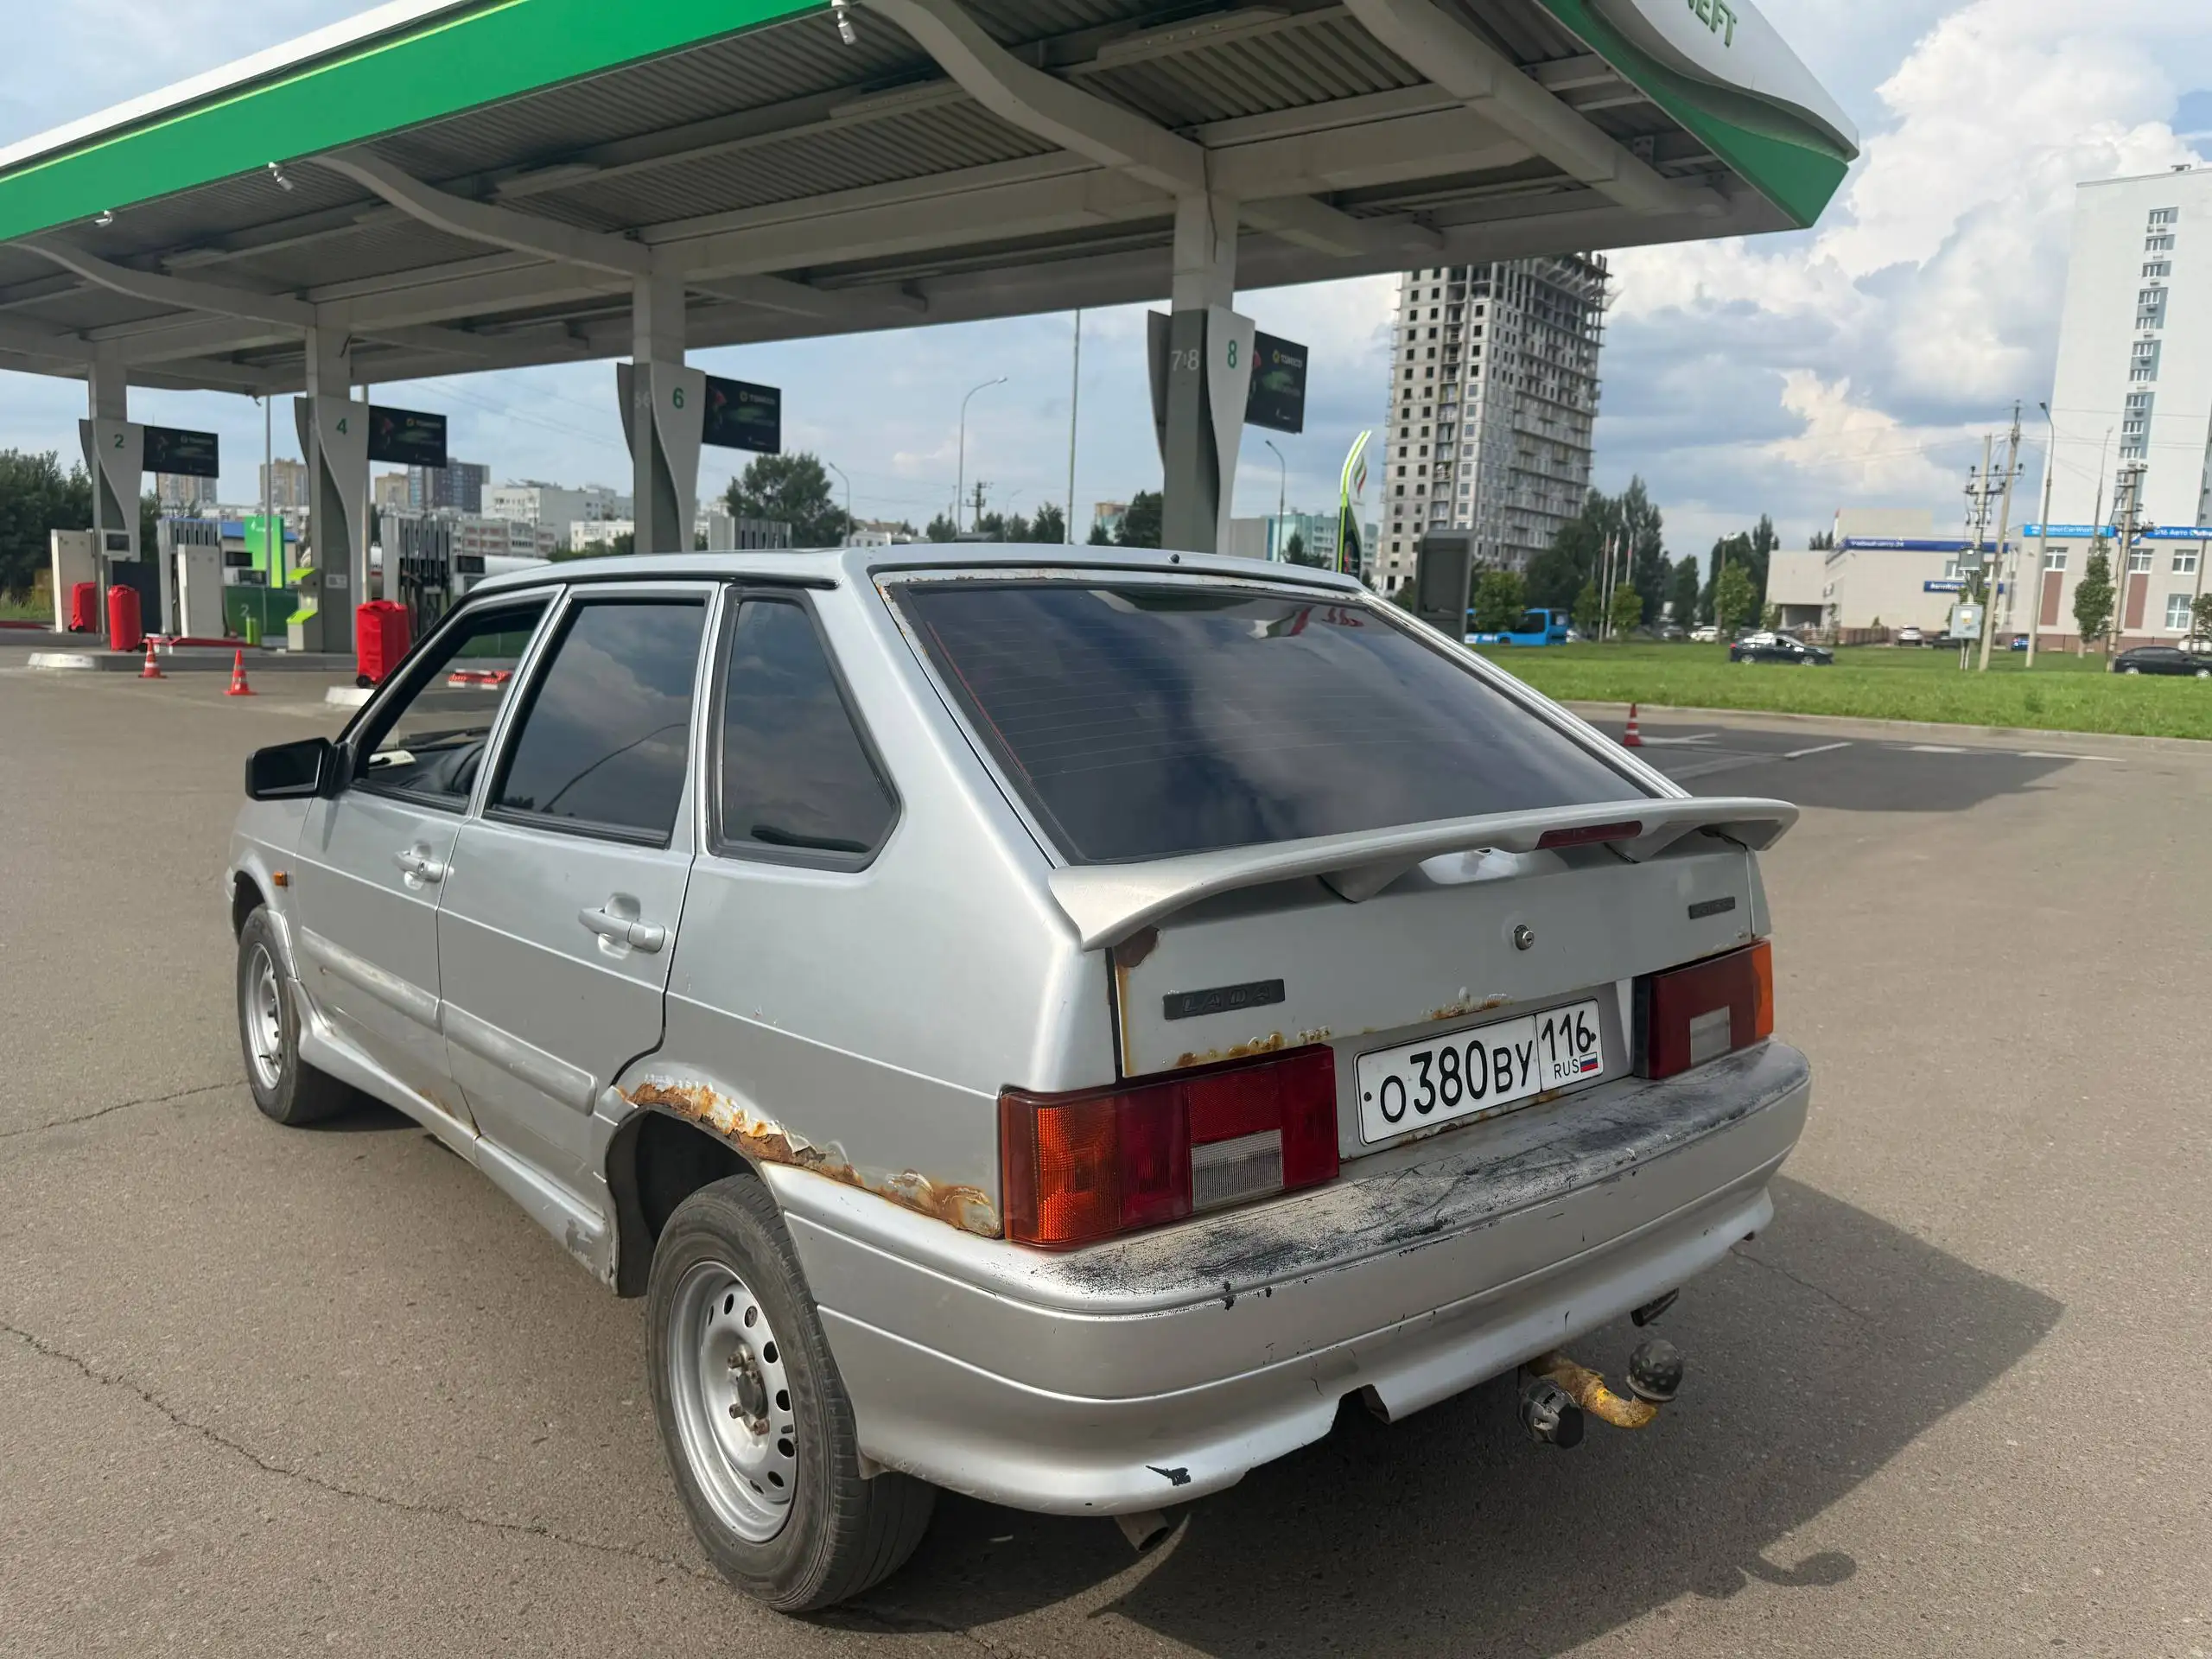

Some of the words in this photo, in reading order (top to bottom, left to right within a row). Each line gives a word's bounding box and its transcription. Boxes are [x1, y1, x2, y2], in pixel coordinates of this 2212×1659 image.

[1687, 0, 1738, 48] EFT
[1227, 339, 1237, 369] 8
[672, 387, 685, 410] 6
[335, 417, 348, 435] 4
[113, 434, 125, 449] 2
[1182, 985, 1271, 1013] LADA
[1541, 1010, 1592, 1062] 116
[1554, 1058, 1580, 1079] RUS
